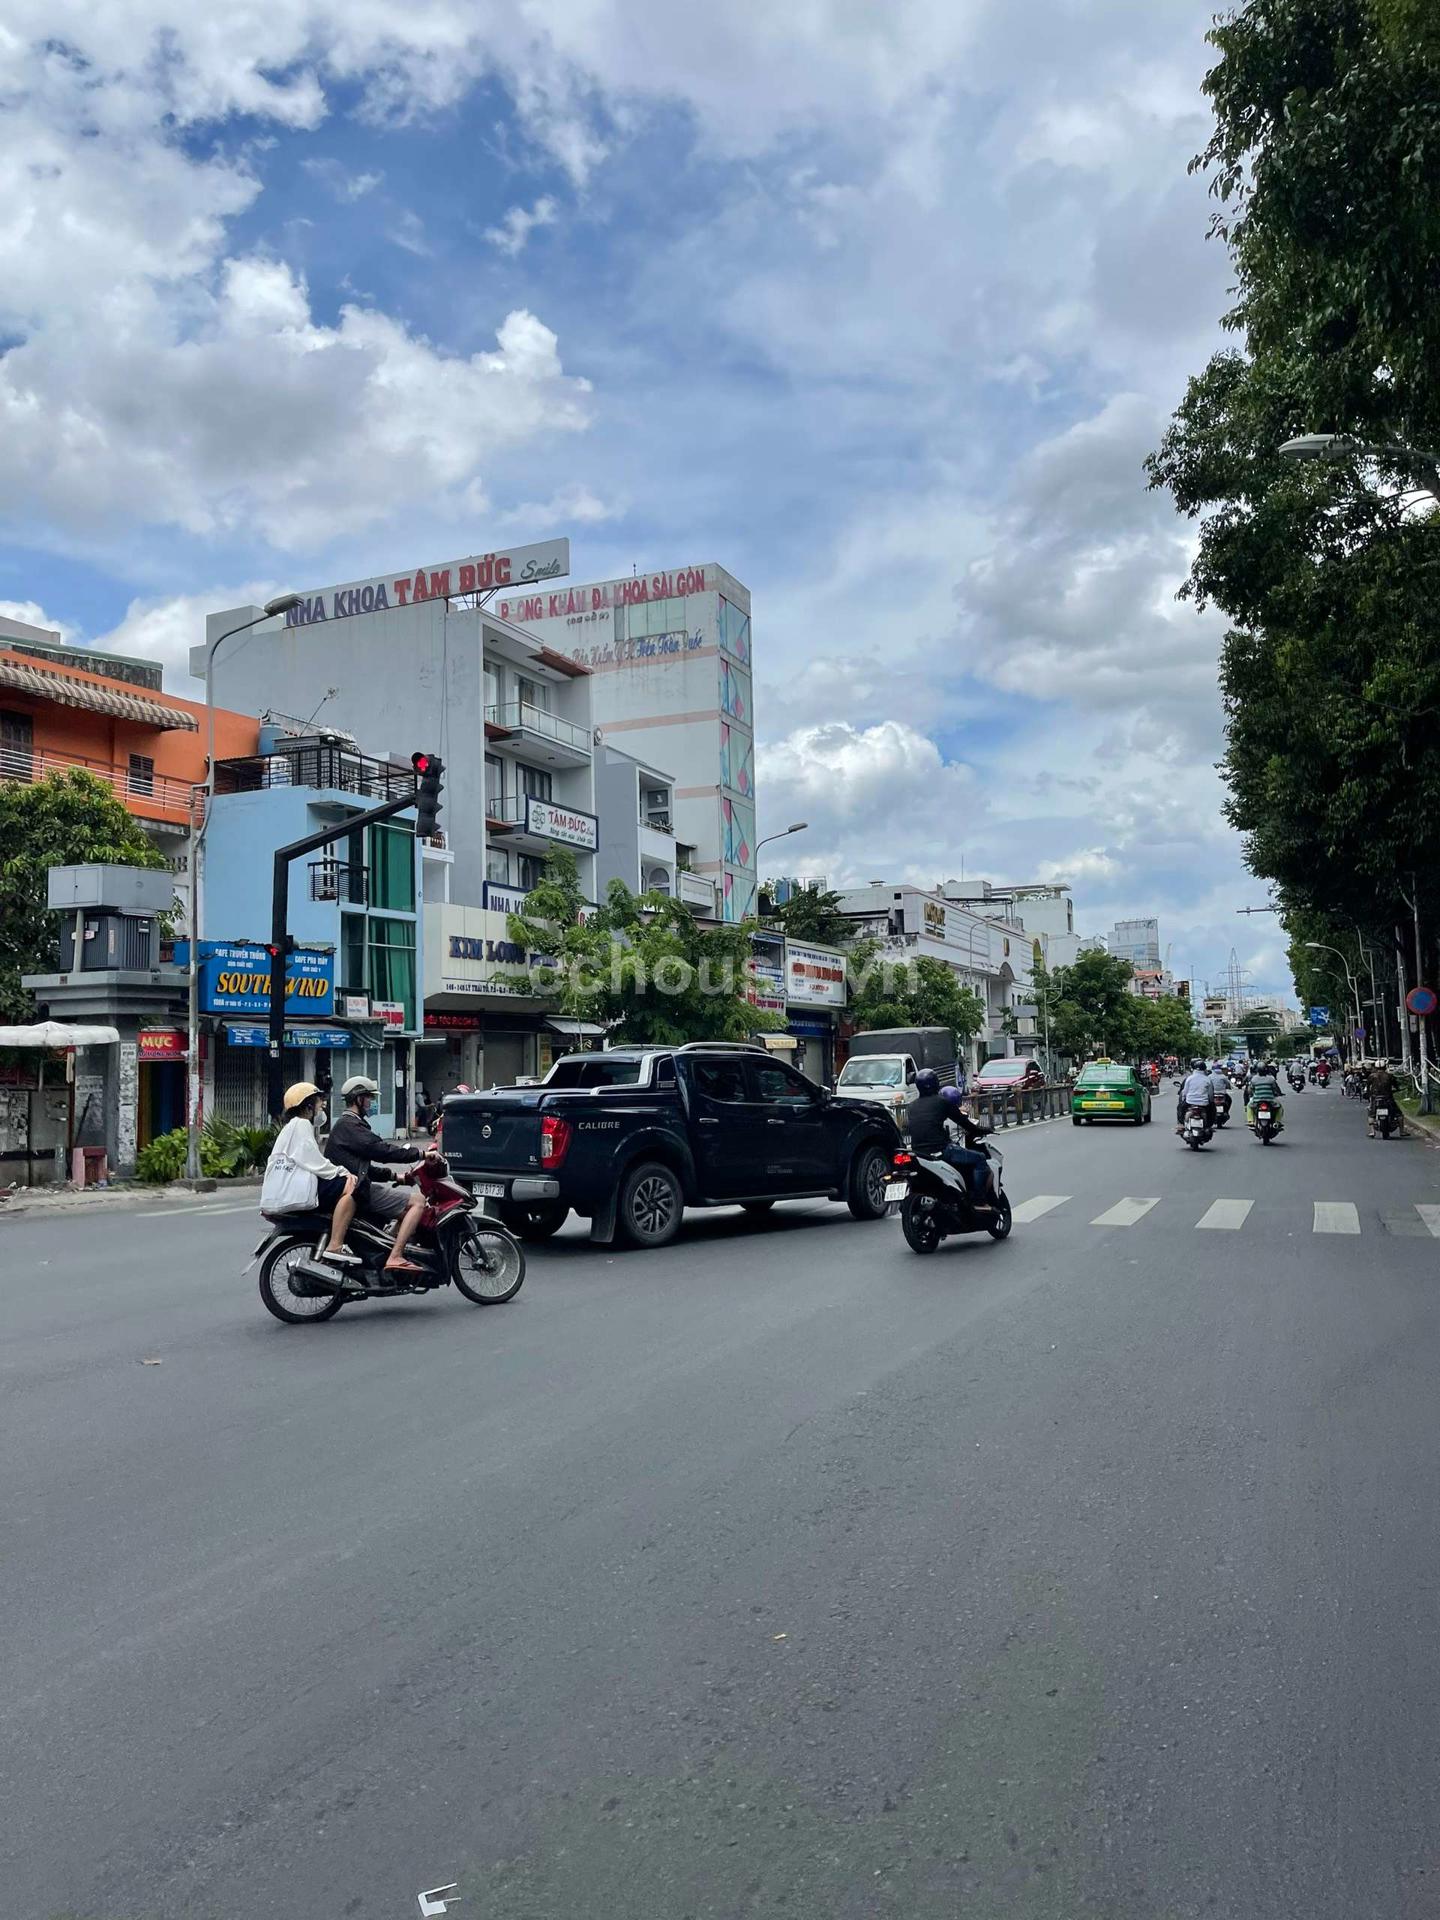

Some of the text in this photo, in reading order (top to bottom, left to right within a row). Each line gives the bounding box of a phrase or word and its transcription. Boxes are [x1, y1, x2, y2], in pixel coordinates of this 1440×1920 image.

[285, 596, 326, 627] NHA
[334, 584, 389, 617] KHOA
[394, 568, 451, 605] TÂM
[458, 553, 512, 592] ĐỨC
[614, 579, 649, 605] KHOA
[652, 571, 673, 598] SÀI
[676, 567, 706, 596] GÒN
[548, 809, 567, 828] TÂM
[567, 816, 587, 834] ĐỨC
[490, 895, 511, 913] NHA
[449, 935, 484, 961] KIM
[486, 940, 527, 965] LONG
[141, 1035, 174, 1049] MỰC
[298, 1037, 321, 1046] WIND
[578, 1121, 621, 1131] CALIBRE
